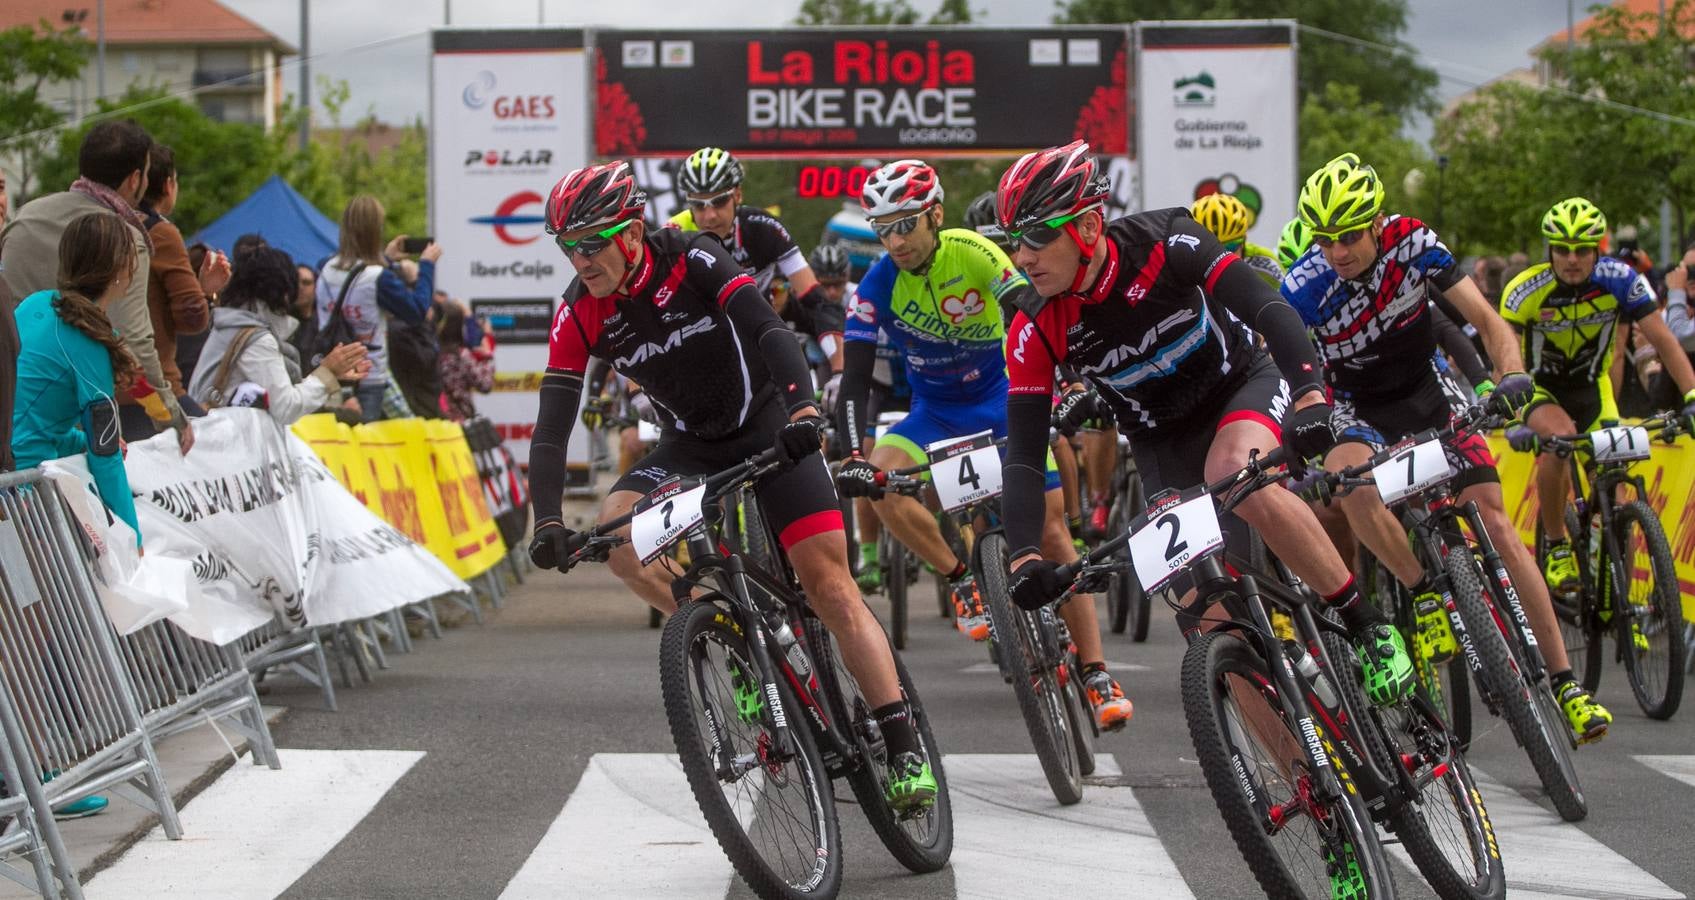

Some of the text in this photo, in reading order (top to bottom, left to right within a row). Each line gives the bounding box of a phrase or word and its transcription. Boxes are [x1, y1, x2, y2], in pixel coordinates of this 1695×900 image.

[747, 40, 814, 85] La
[834, 40, 975, 91] Rioja
[493, 95, 556, 119] GAES
[747, 88, 976, 127] BIKE RACE
[900, 126, 976, 144] LOGROÑO
[1174, 118, 1247, 133] Gobierno
[464, 149, 553, 167] POLAR
[1174, 135, 1263, 151] de La Rioja
[901, 299, 998, 338] Primaflor
[1603, 428, 1635, 452] 11
[958, 454, 980, 490] 4
[1395, 449, 1415, 486] 7
[958, 489, 990, 503] VENTURA
[1147, 499, 1181, 521] BIKE RACE
[660, 499, 674, 530] 1
[655, 523, 684, 547] COLOMA
[1155, 512, 1188, 562] 2
[1168, 552, 1190, 571] SOTO
[1505, 587, 1538, 646] DT SWISS
[1450, 611, 1482, 672] DT SWISS
[765, 683, 787, 728] ROCKSHOX
[1299, 717, 1329, 767] ROCKSHOX
